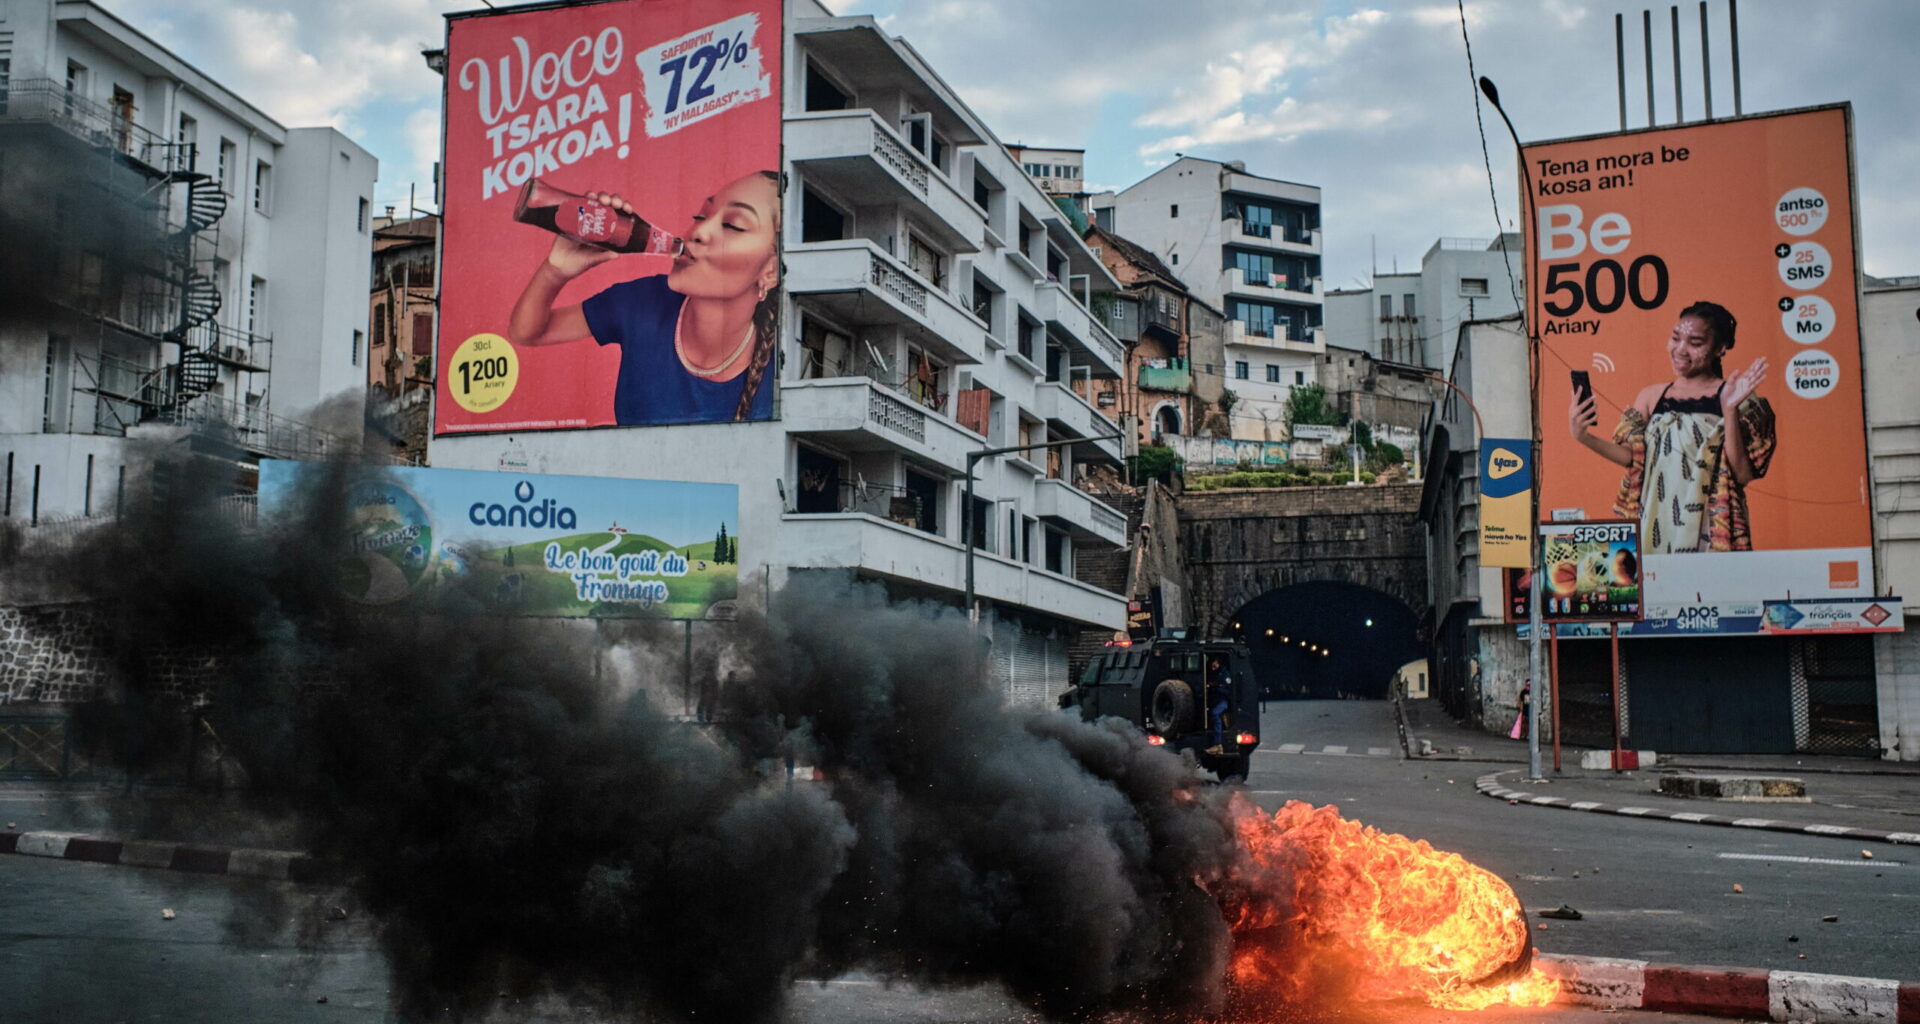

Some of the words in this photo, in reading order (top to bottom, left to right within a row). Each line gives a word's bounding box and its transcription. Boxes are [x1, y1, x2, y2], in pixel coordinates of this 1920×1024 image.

[659, 30, 747, 115] 72%
[486, 83, 608, 159] TSARA
[1537, 159, 1589, 178] Tena
[1596, 151, 1654, 171] mora
[1661, 146, 1690, 163] be
[1538, 177, 1591, 197] kosa
[1779, 197, 1824, 212] antso
[1780, 213, 1809, 228] 500
[1538, 204, 1632, 260] Be
[1795, 250, 1815, 264] 25
[1787, 265, 1825, 281] SMS
[1543, 255, 1669, 318] 500
[1799, 304, 1818, 318] 25
[1544, 318, 1601, 336] Ariary
[1796, 320, 1822, 334] Mo
[1795, 378, 1830, 389] feno
[469, 499, 576, 530] candia
[1574, 527, 1631, 542] SPORT
[546, 544, 575, 570] Le
[581, 551, 615, 571] bon
[620, 550, 657, 578] goût
[663, 553, 686, 573] du
[575, 573, 666, 608] Fromage
